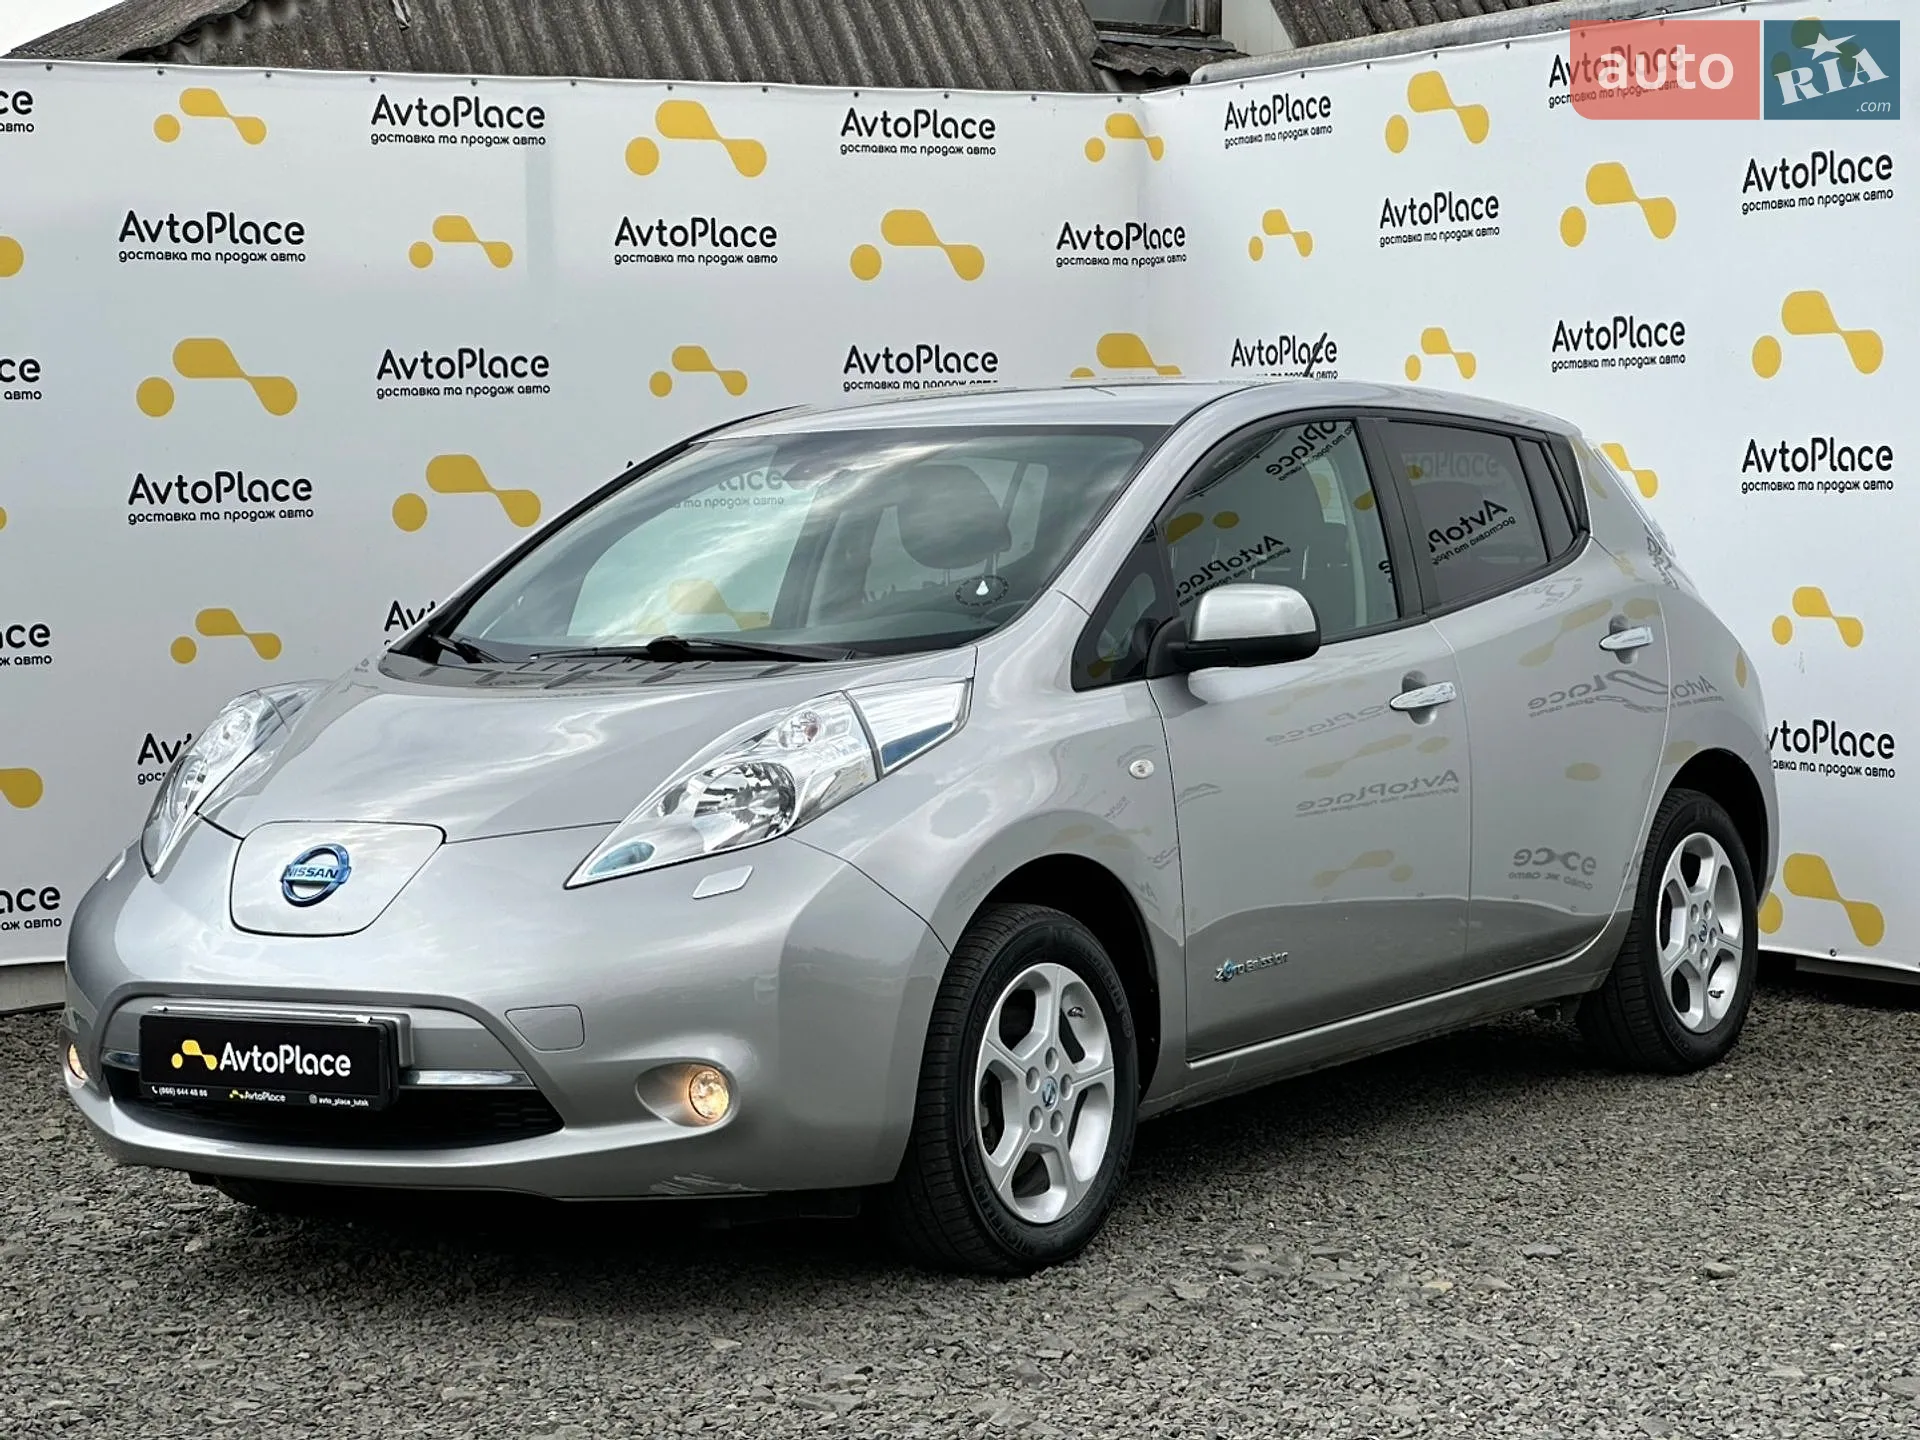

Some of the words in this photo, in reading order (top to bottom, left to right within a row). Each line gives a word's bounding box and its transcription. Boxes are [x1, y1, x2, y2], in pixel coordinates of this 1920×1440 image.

[371, 94, 545, 129] AvtoPlace
[841, 107, 995, 140] AvtoPlace
[1224, 93, 1331, 131] AvtoPlace
[1742, 150, 1893, 194] AvtoPlace
[1380, 191, 1499, 229] AvtoPlace
[119, 210, 305, 245] AvtoPlace
[615, 216, 777, 247] AvtoPlace
[1056, 222, 1185, 250] AvtoPlace
[1552, 315, 1685, 352] AvtoPlace
[377, 348, 549, 380] AvtoPlace
[844, 344, 998, 374] AvtoPlace
[1742, 437, 1893, 473] AvtoPlace
[128, 471, 312, 505] AvtoPlace
[286, 866, 339, 879] NISSAN
[220, 1042, 351, 1076] AvtoPlace
